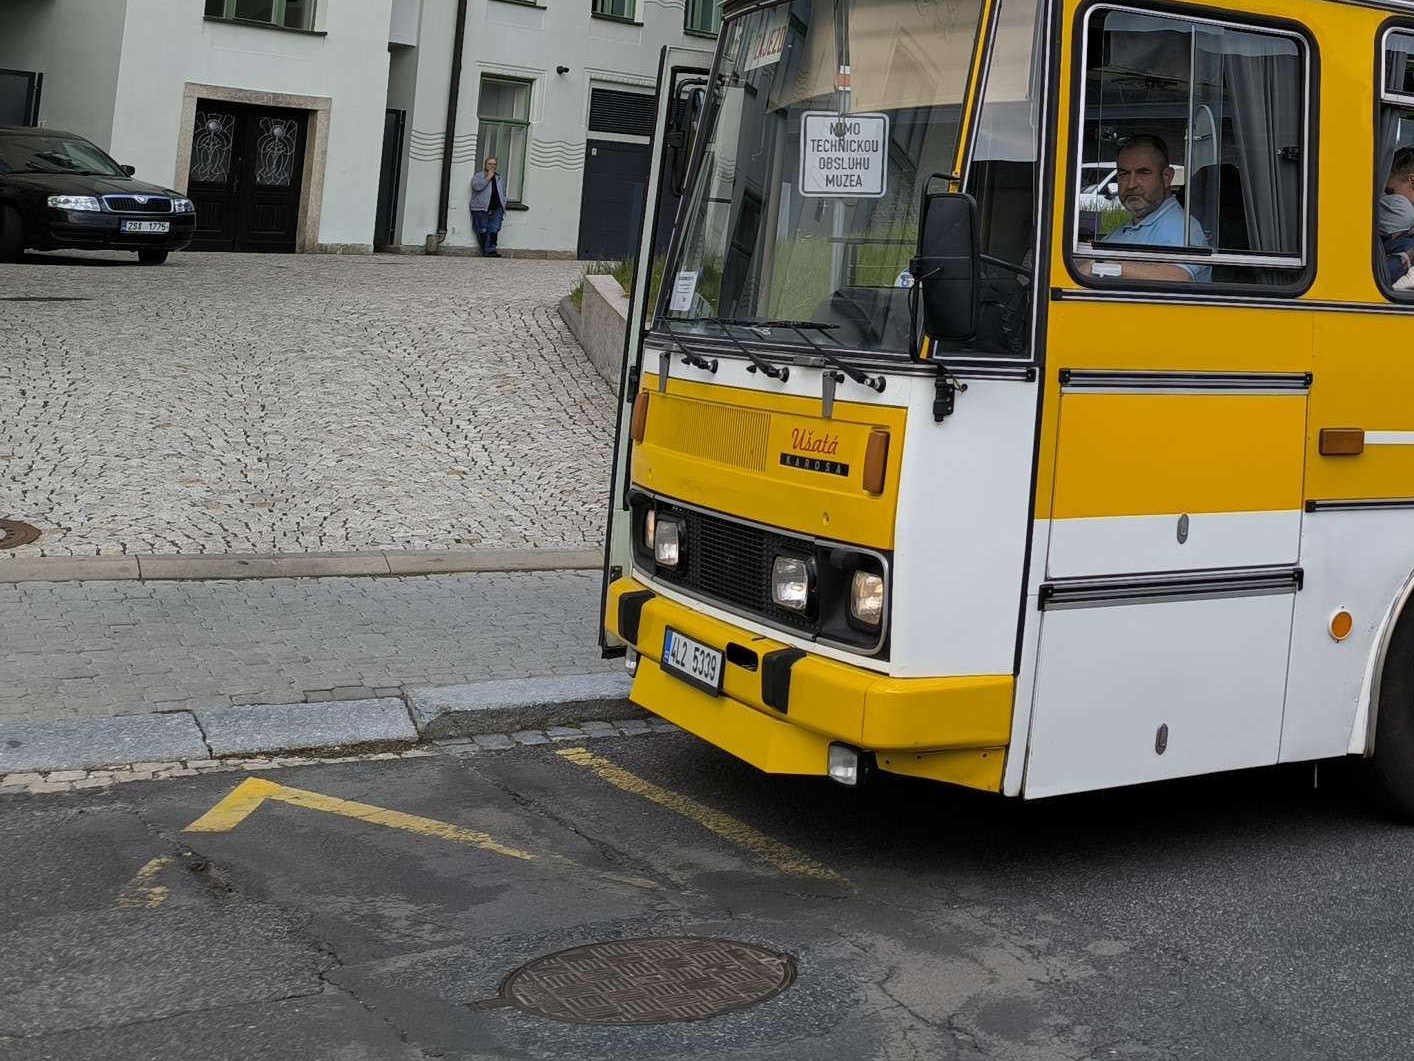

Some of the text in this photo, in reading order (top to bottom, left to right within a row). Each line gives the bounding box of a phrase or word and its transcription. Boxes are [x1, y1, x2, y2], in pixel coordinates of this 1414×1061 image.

[829, 122, 861, 136] MMO
[810, 139, 879, 153] TECHNICKOU
[818, 156, 870, 170] OBSLUHU
[825, 174, 863, 188] MUZEA
[791, 427, 839, 456] Ušatá
[785, 455, 842, 475] KAROSA
[671, 636, 717, 681] 4L2 5339
